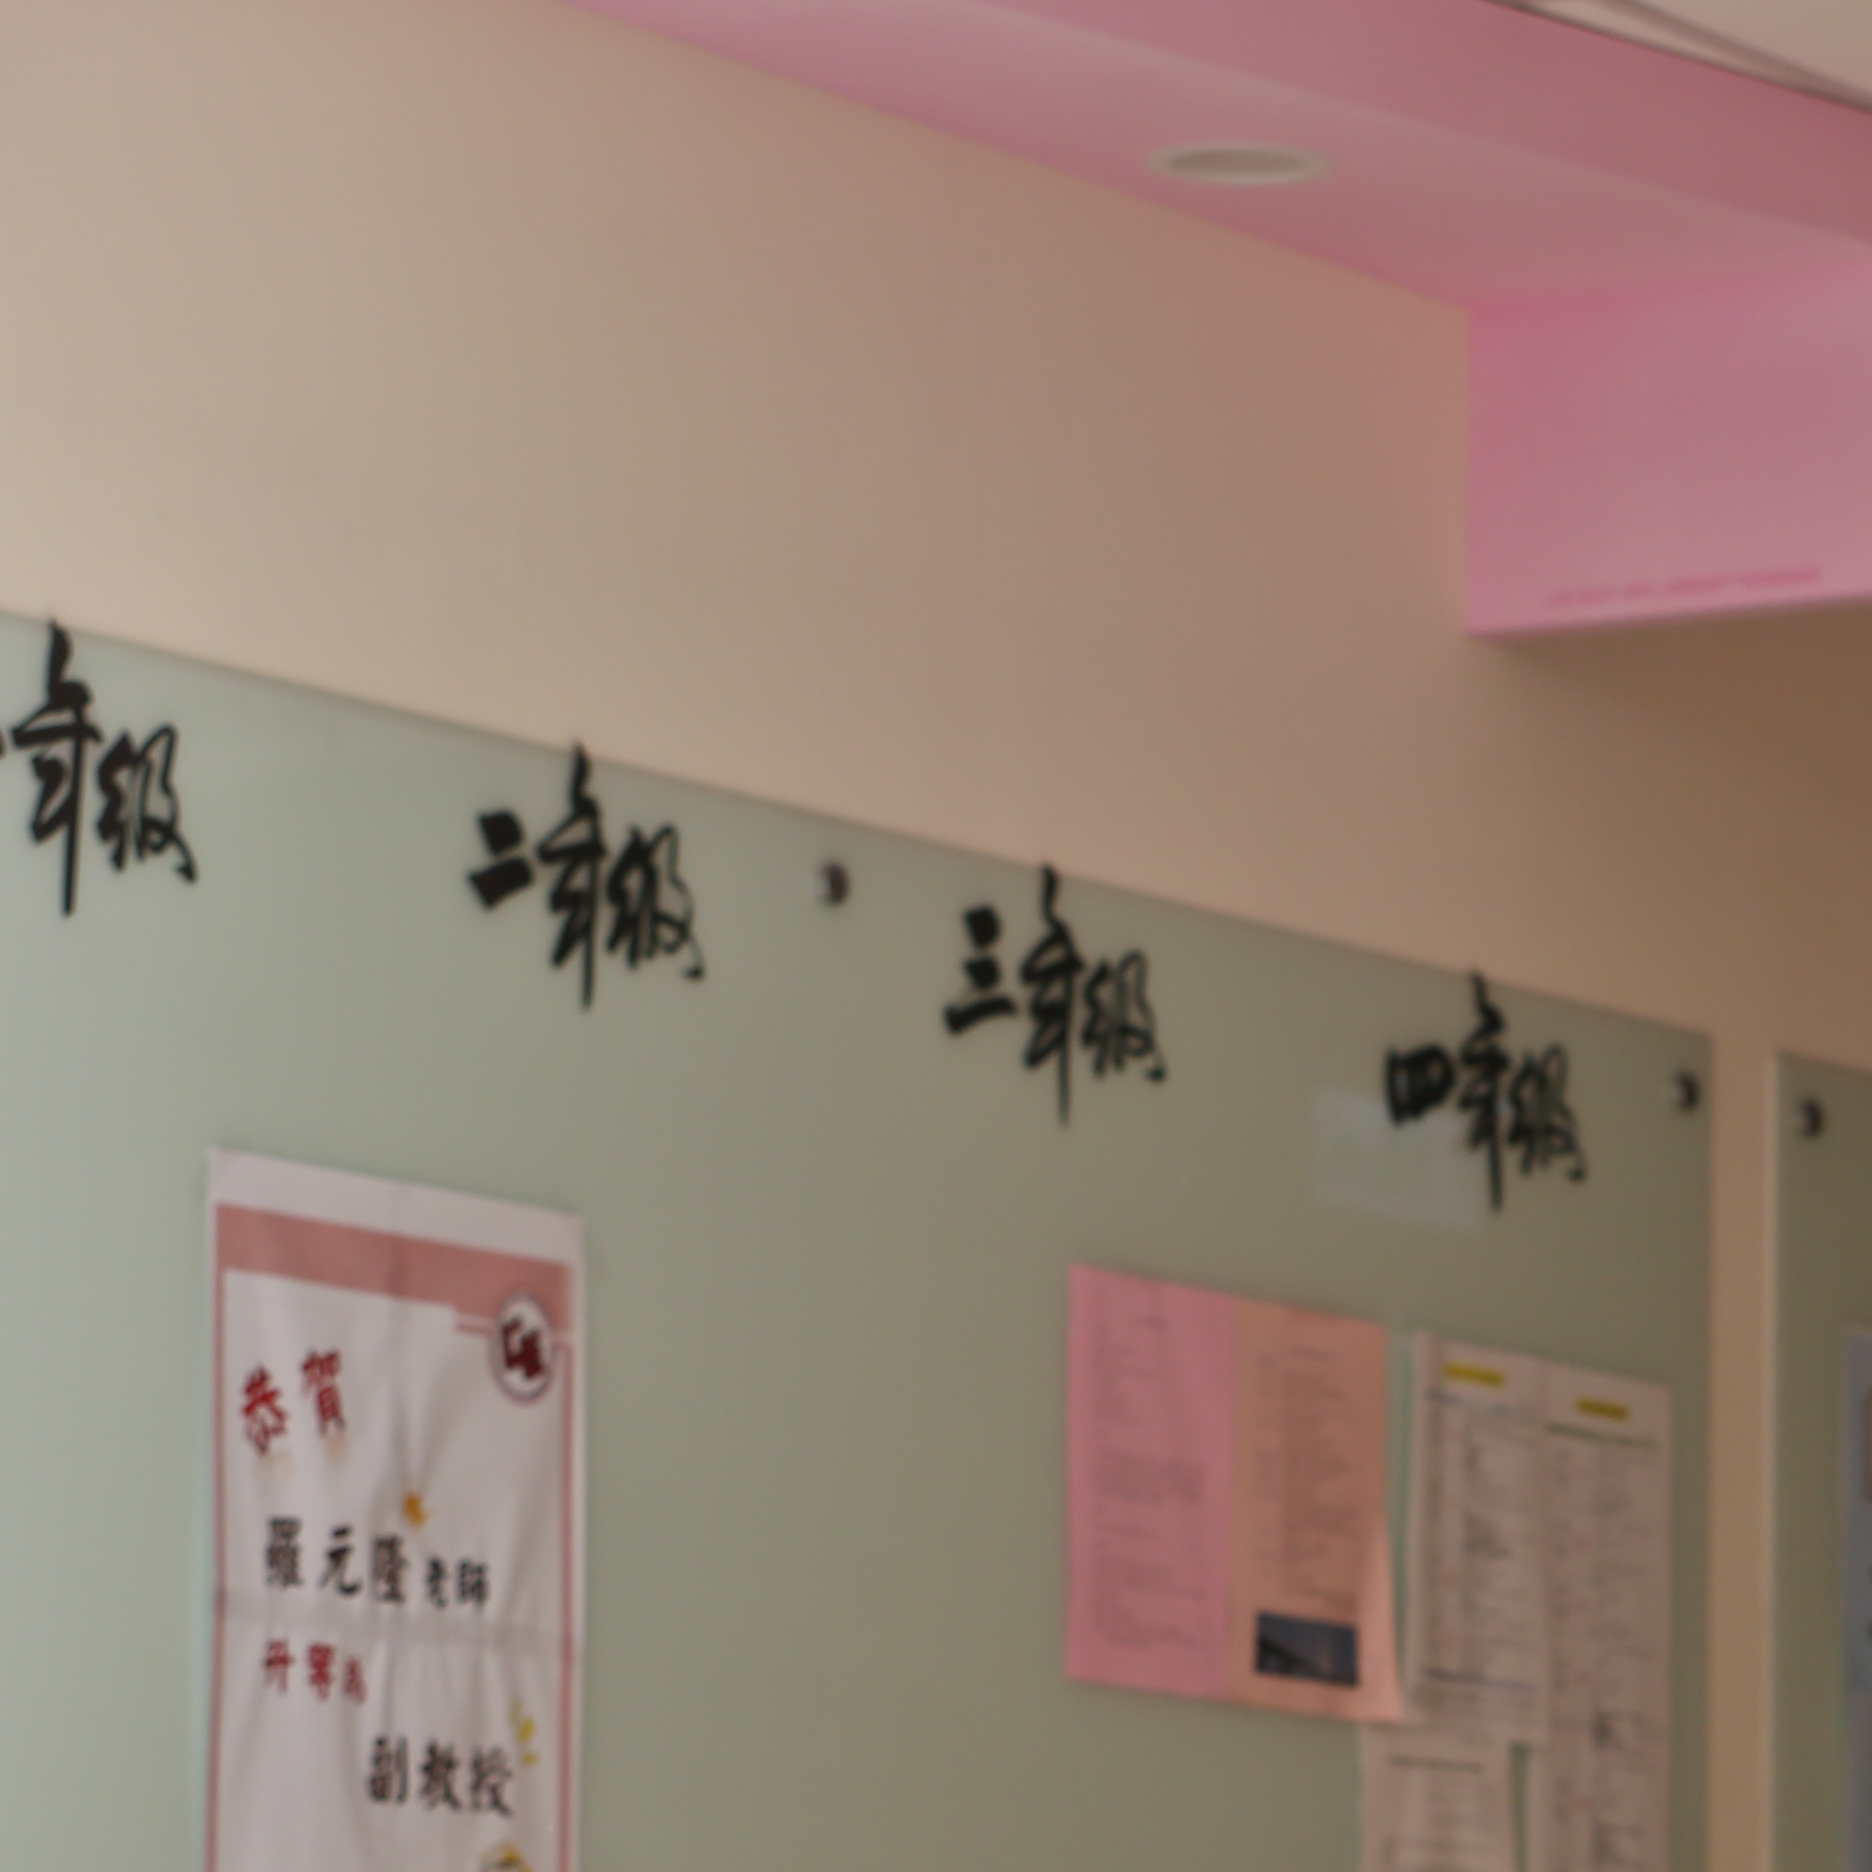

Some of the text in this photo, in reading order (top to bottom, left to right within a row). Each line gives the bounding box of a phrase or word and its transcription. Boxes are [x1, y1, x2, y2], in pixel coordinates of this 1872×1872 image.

[0, 621, 198, 915] 年級
[466, 743, 705, 1008] 二年級
[942, 864, 1167, 1126] 三年級
[1382, 970, 1587, 1210] 四年級
